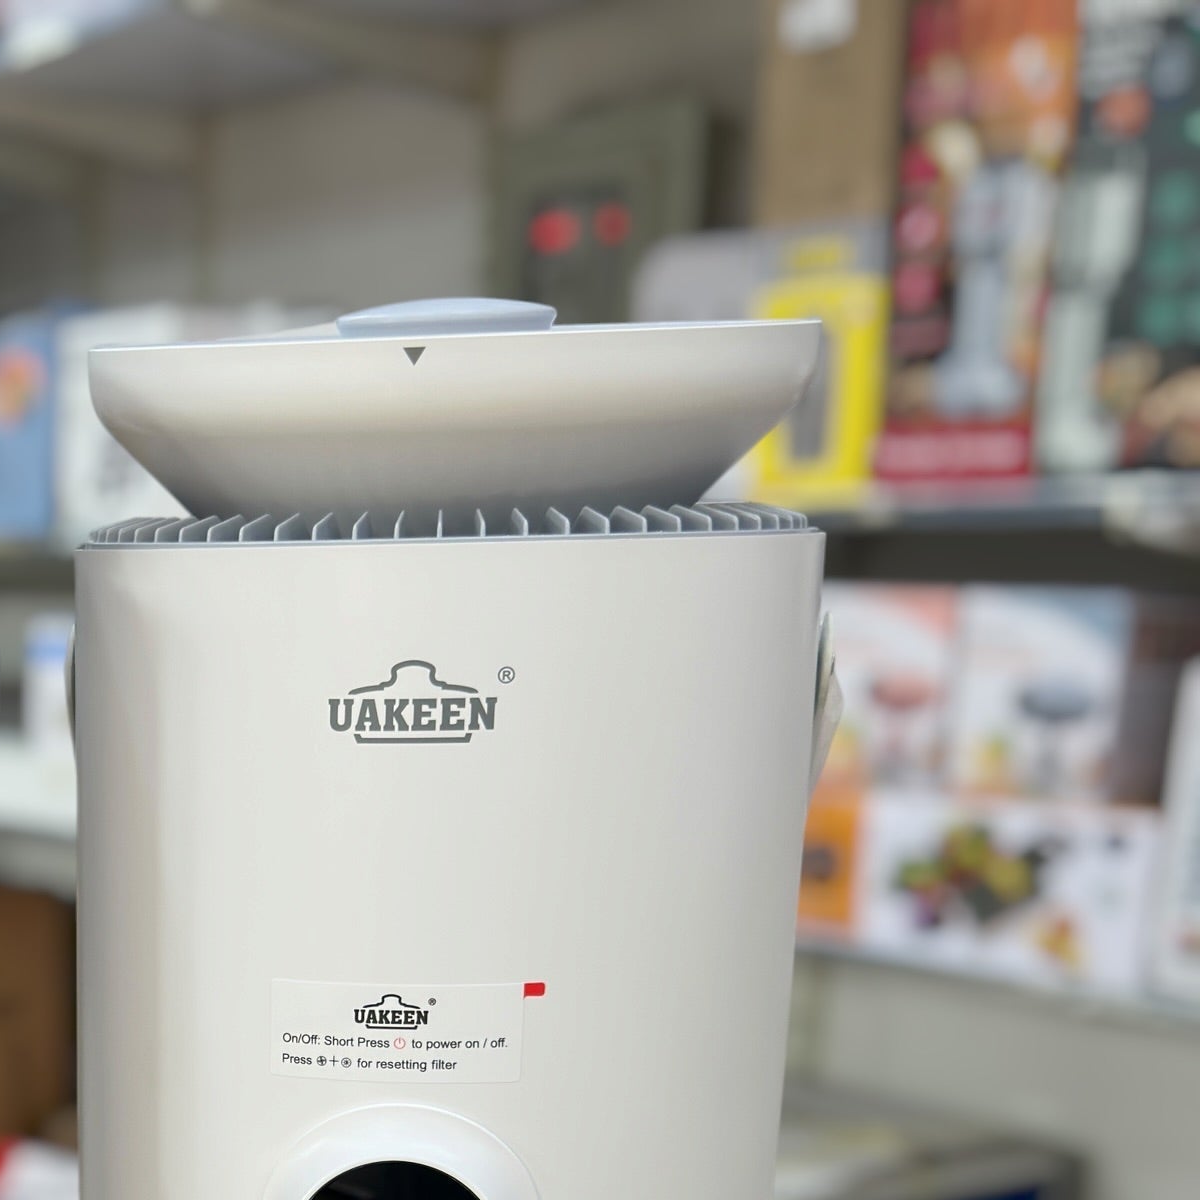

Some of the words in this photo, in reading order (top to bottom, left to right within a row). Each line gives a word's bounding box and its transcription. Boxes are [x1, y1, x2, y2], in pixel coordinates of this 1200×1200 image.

[328, 697, 498, 732] UAKEEN
[353, 1009, 429, 1025] UAKEEN
[282, 1032, 321, 1046] On/Off:
[324, 1035, 354, 1047] Short
[358, 1037, 390, 1048] Press
[411, 1039, 423, 1049] to
[426, 1040, 462, 1051] power
[465, 1039, 480, 1049] on
[490, 1037, 508, 1048] off.
[282, 1054, 312, 1065] Press
[357, 1058, 372, 1069] for
[376, 1058, 427, 1072] resetting
[431, 1059, 457, 1071] filter
